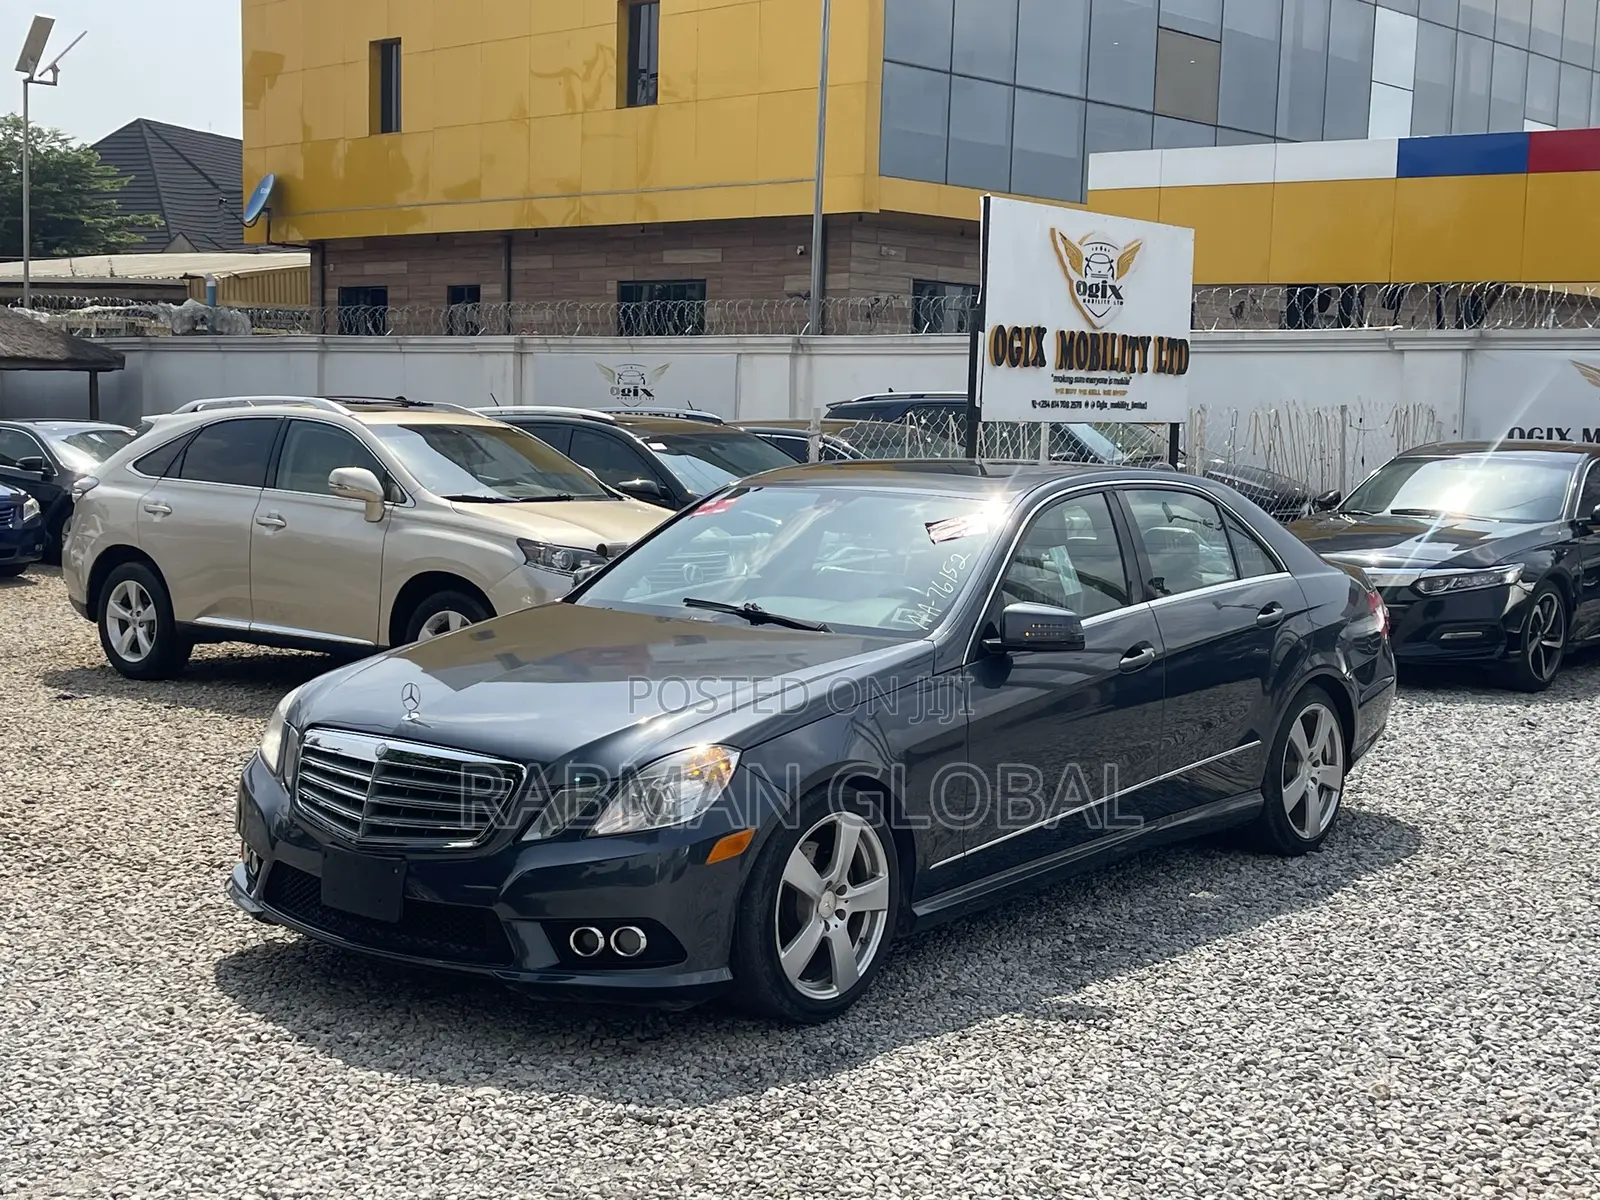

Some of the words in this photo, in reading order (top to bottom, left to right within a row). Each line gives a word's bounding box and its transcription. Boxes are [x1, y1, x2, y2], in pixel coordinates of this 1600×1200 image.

[989, 324, 1047, 368] OGIX
[1055, 330, 1152, 374] MOBILITY
[1153, 335, 1190, 375] LTD
